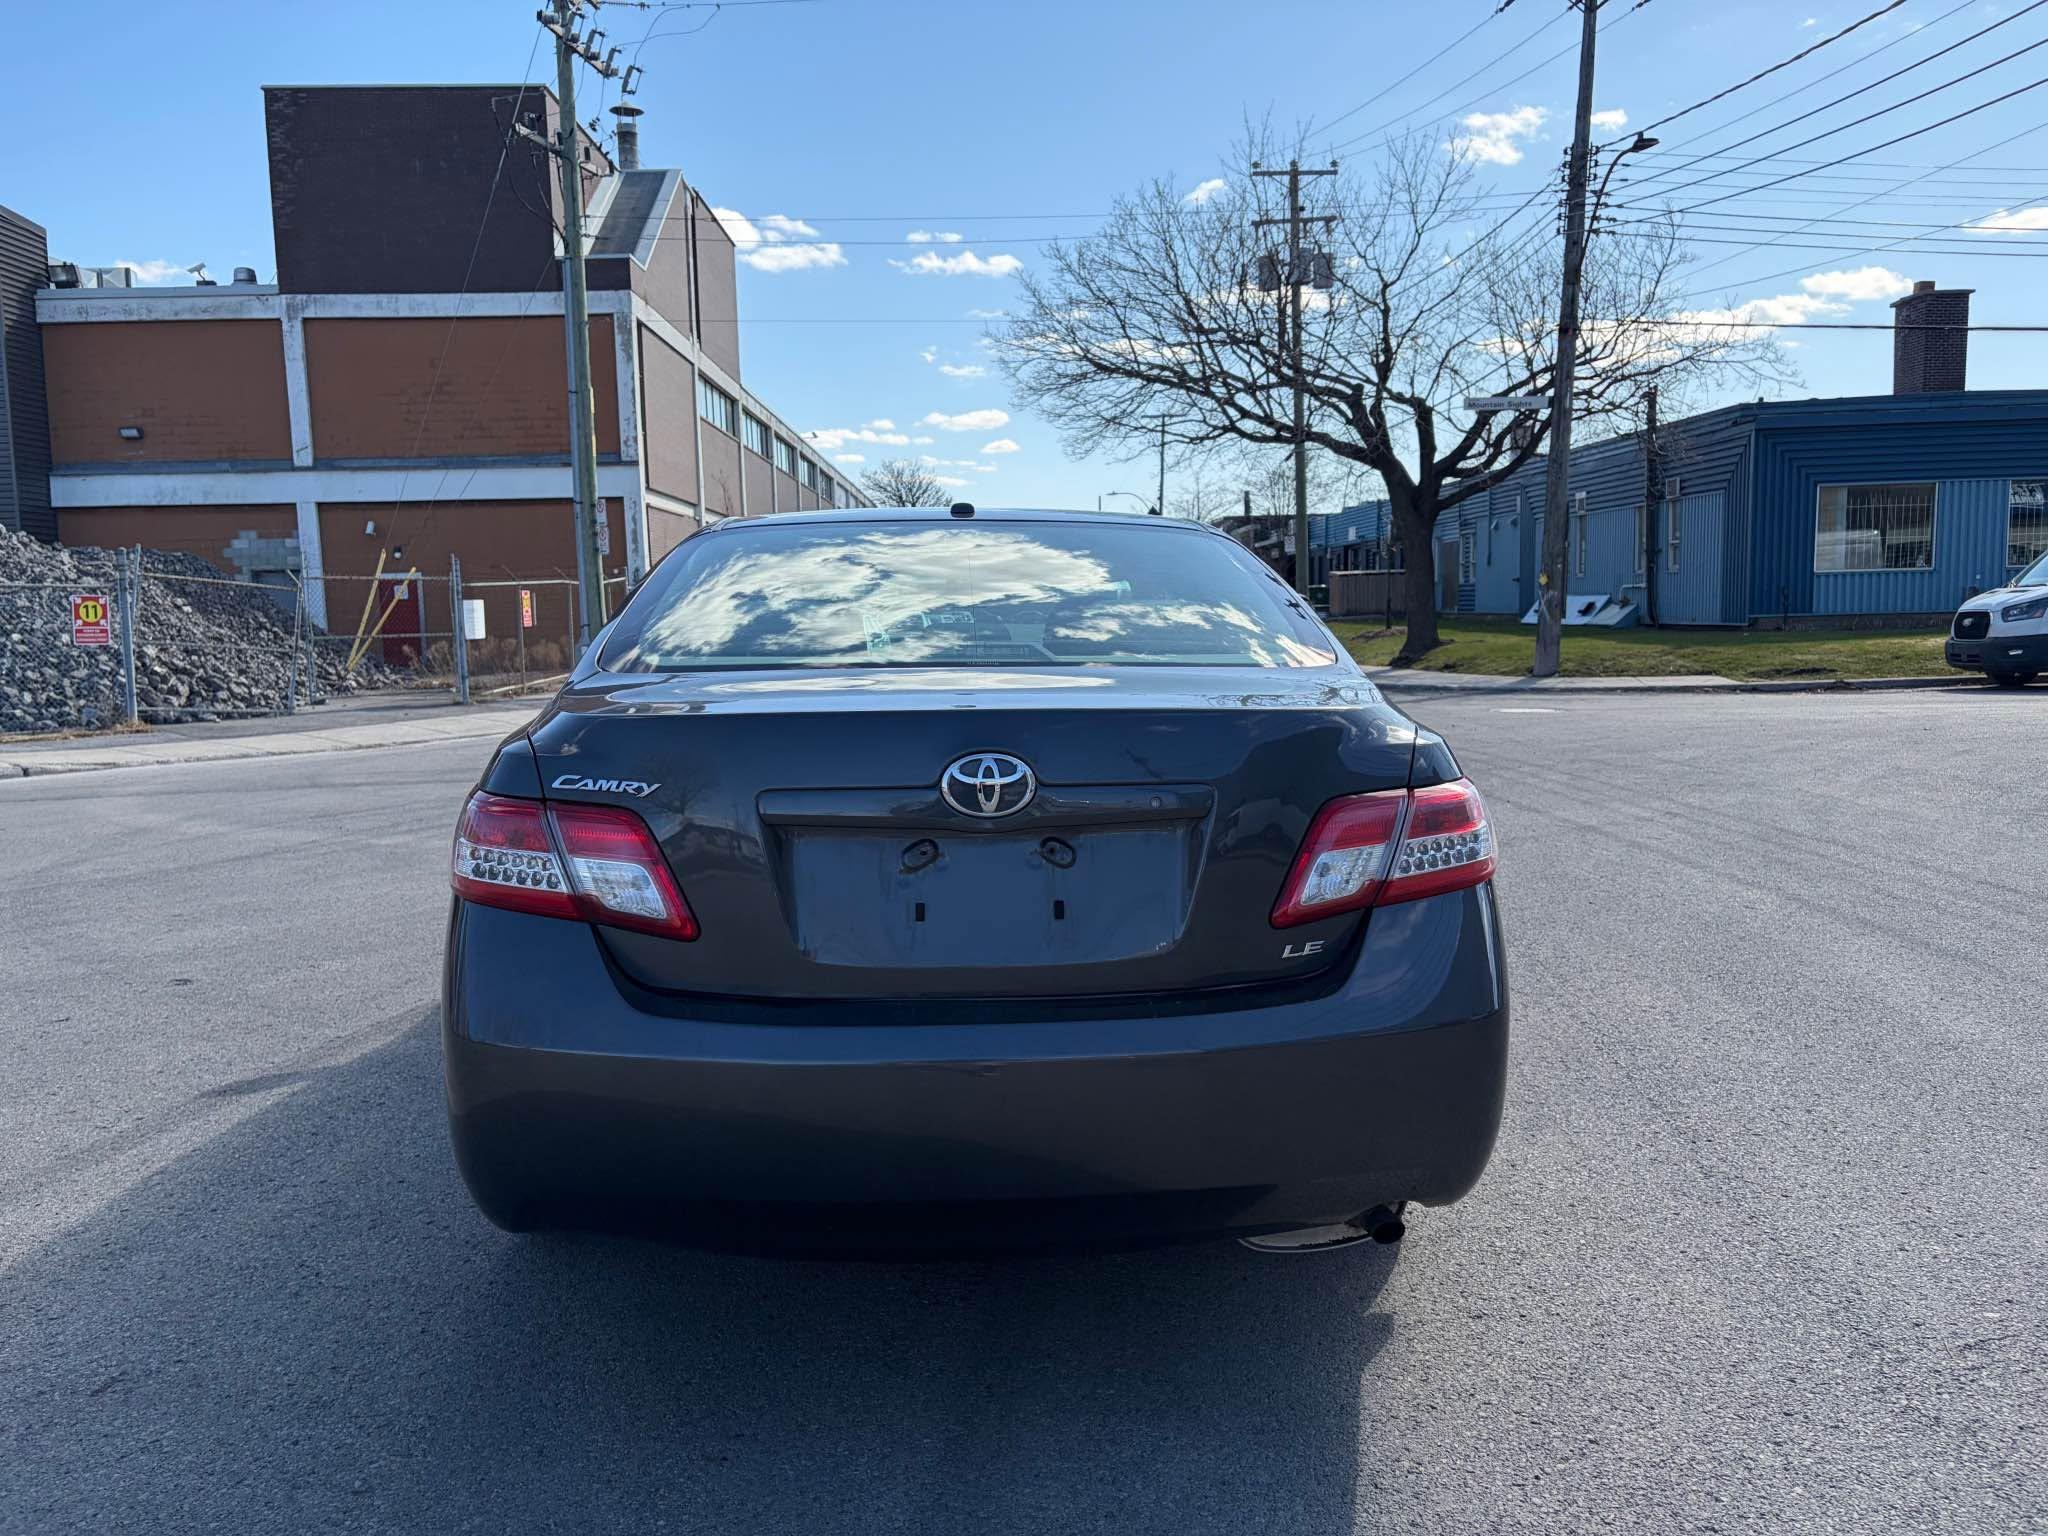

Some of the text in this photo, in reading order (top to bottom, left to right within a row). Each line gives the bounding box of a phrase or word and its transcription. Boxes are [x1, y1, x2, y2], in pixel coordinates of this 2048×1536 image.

[1468, 401, 1505, 409] Mountain
[82, 604, 98, 619] 11
[551, 774, 663, 798] CAMRY
[1281, 940, 1325, 959] LE
